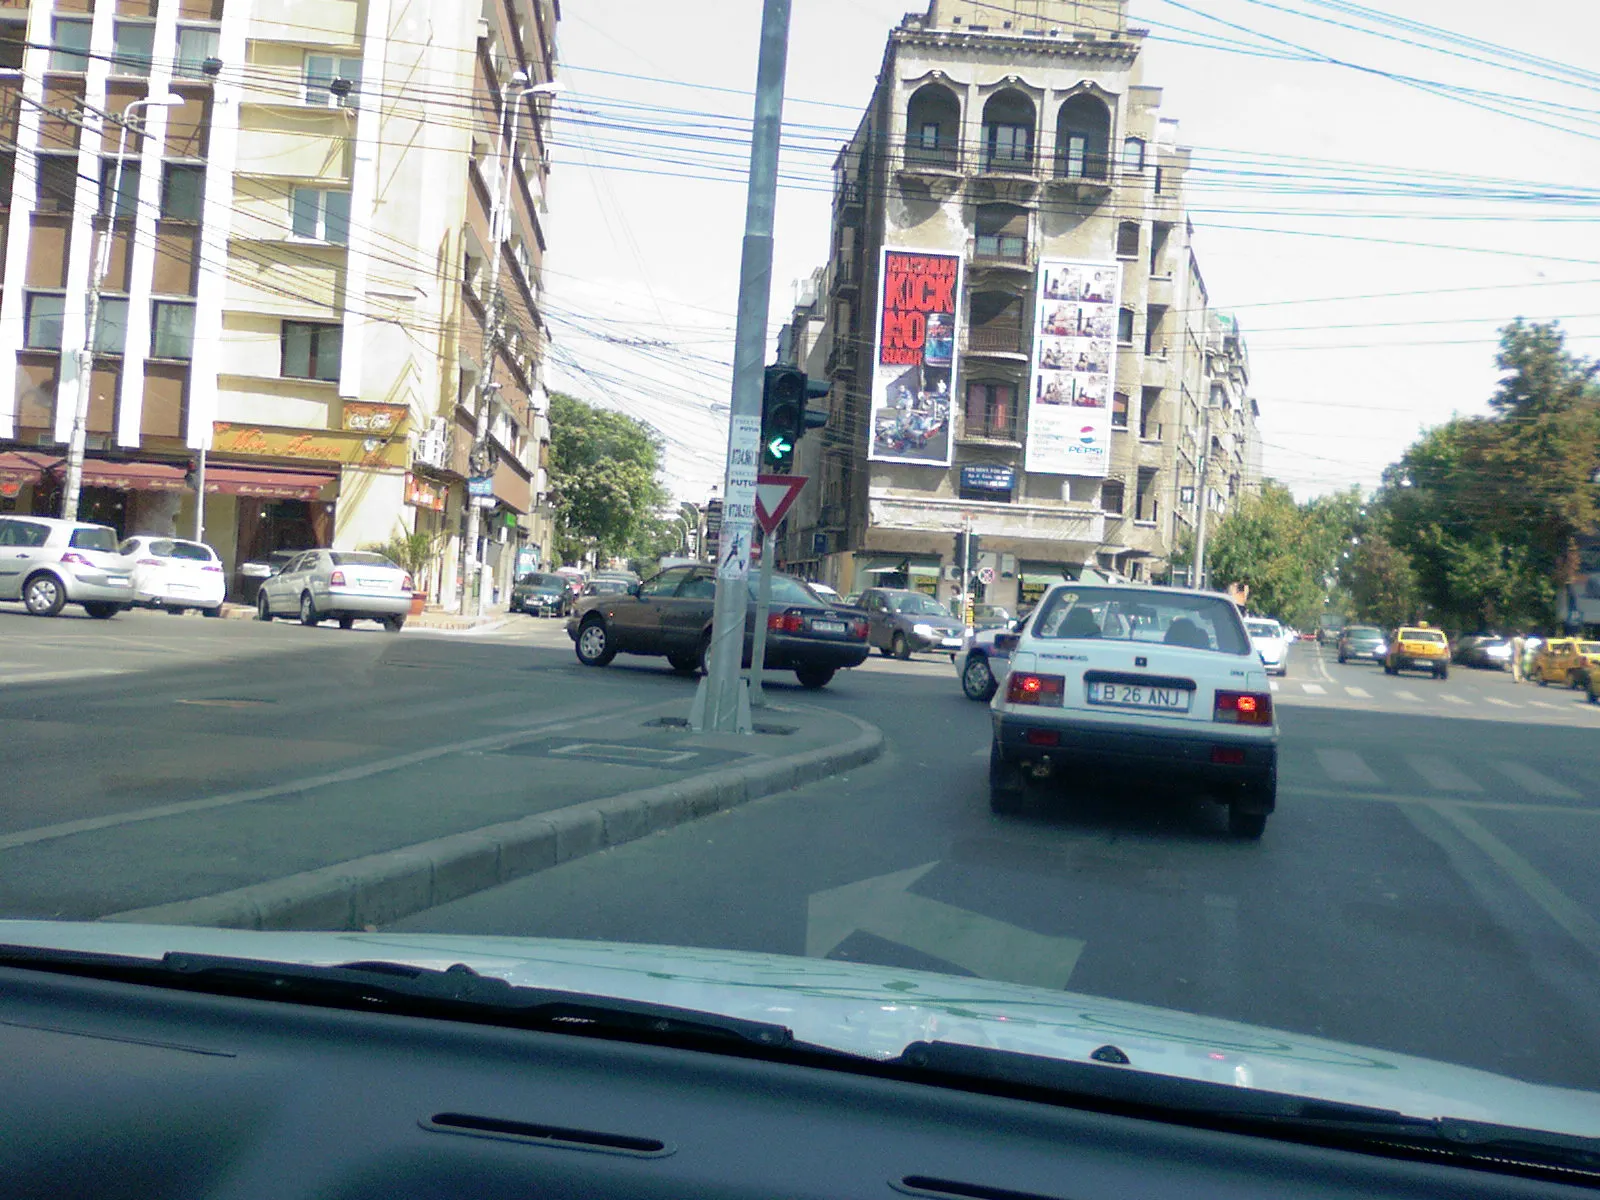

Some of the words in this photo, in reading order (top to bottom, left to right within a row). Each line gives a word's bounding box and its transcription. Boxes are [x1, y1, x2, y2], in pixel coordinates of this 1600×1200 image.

[886, 273, 956, 313] KICK
[884, 310, 925, 349] NO
[1104, 685, 1115, 700] B
[1121, 687, 1141, 702] 26
[1148, 689, 1179, 706] ANJ
